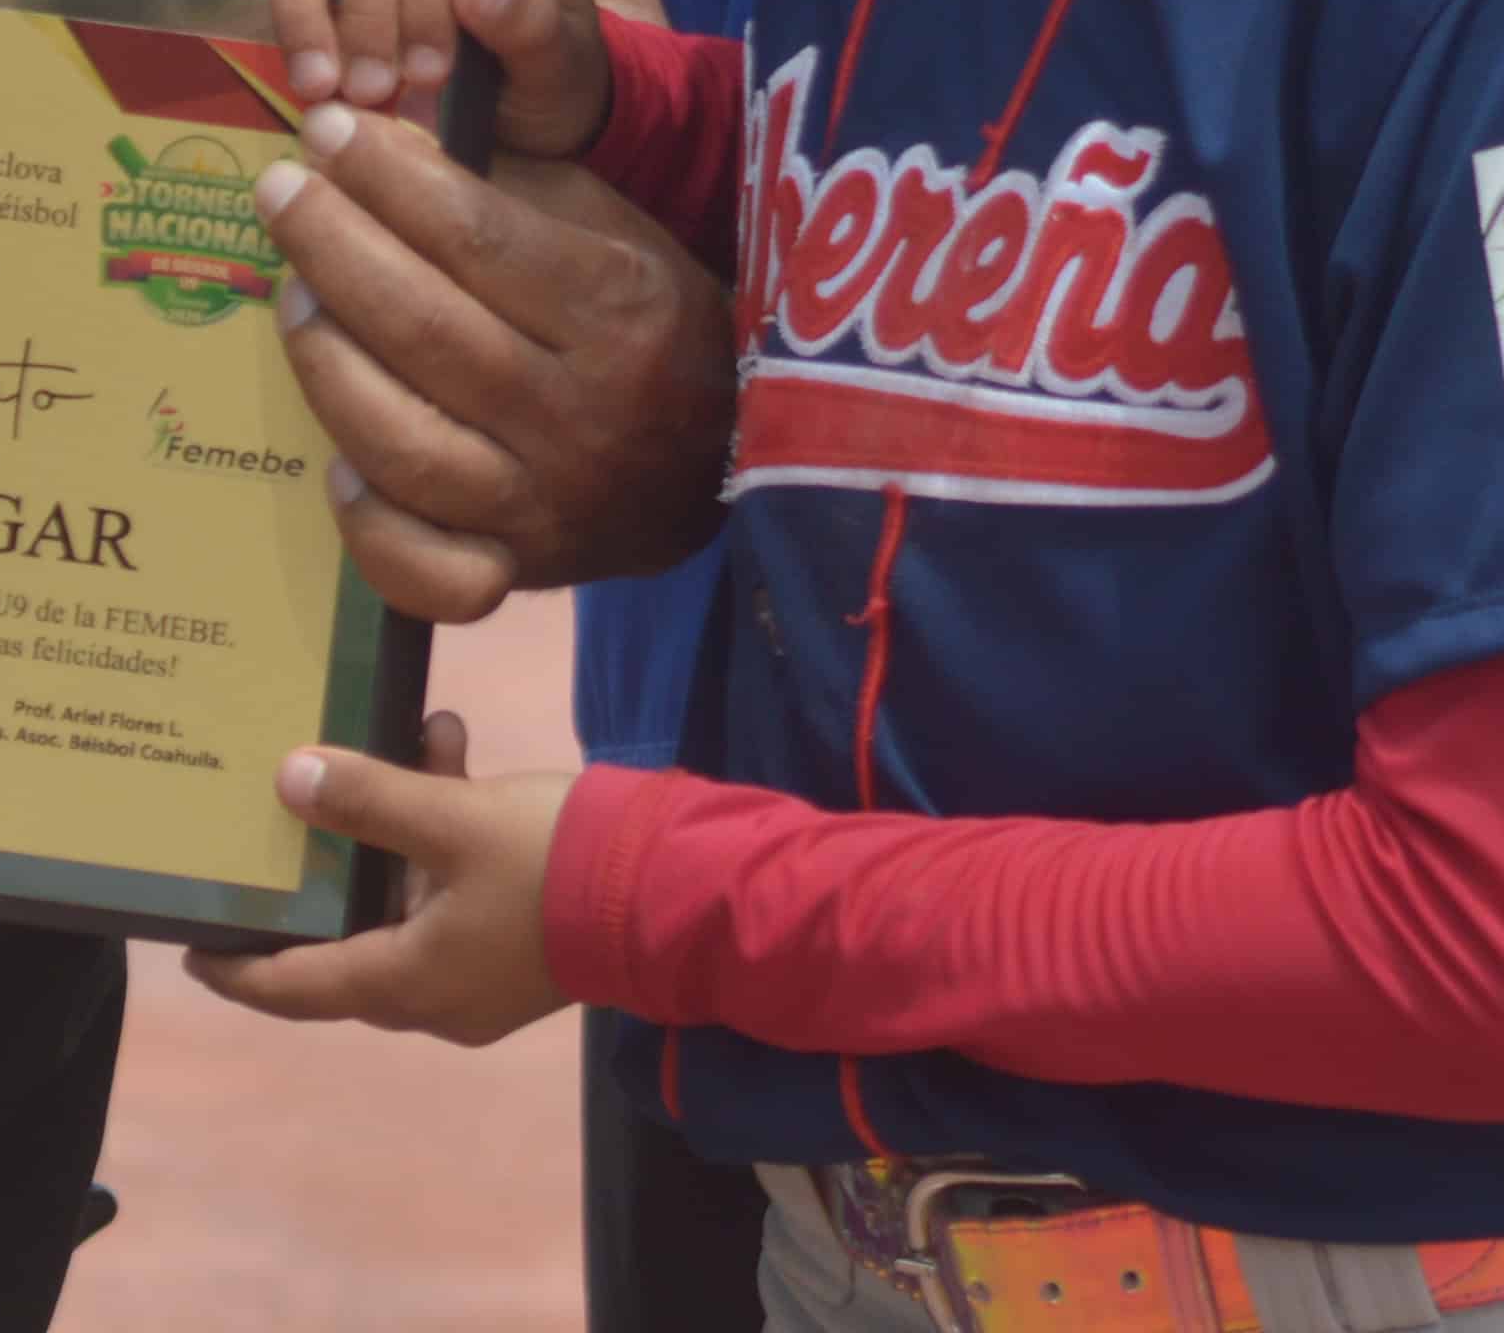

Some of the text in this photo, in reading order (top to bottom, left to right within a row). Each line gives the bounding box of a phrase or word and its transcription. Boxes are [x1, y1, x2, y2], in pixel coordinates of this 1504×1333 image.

[137, 181, 255, 219] TORNEO
[165, 436, 305, 477] Femebe
[35, 598, 65, 625] de
[74, 602, 95, 629] la
[105, 607, 235, 647] FEMEBE.
[32, 636, 179, 677] felicidades!
[13, 700, 55, 721] Prof.
[60, 705, 104, 726] Ariel
[110, 712, 164, 736] Flores
[14, 727, 62, 749] Asoc.
[69, 734, 135, 758] Béisbol
[141, 743, 224, 770] Coahuila.
